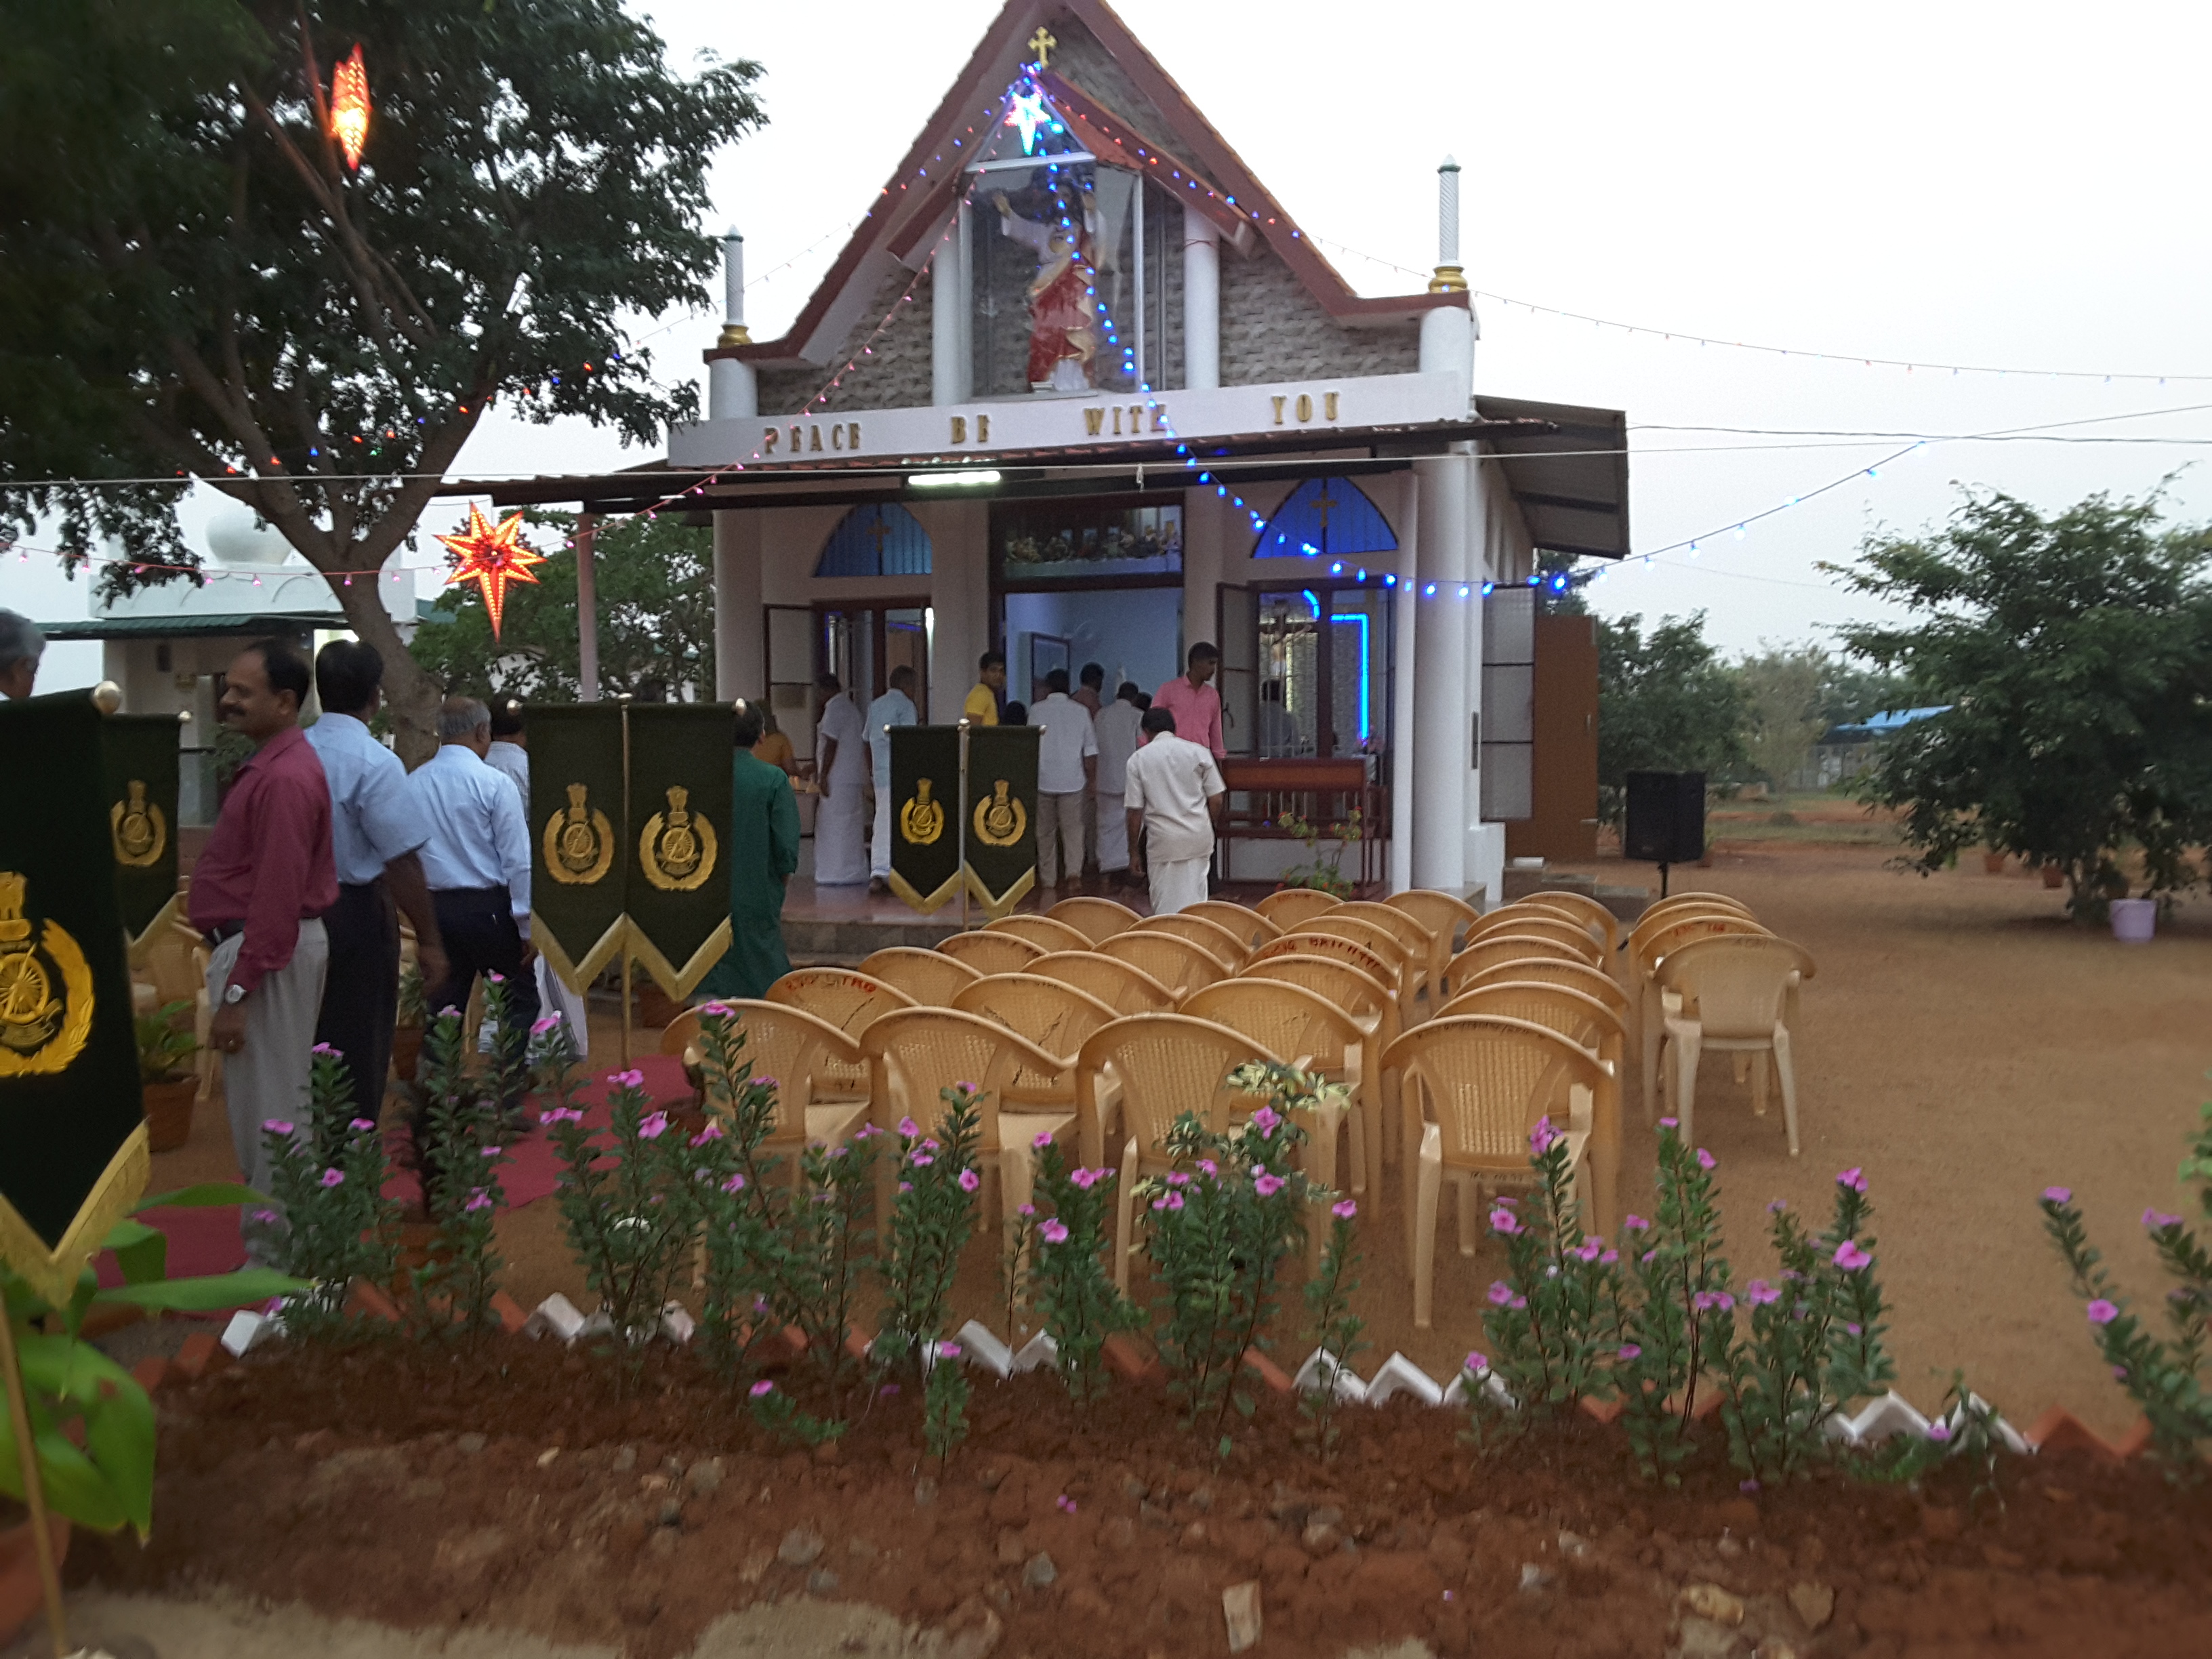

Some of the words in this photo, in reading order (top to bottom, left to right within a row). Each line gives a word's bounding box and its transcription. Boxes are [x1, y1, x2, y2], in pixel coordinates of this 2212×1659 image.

[763, 422, 861, 454] PEACE
[950, 415, 991, 444] BE
[1271, 391, 1340, 425] YOU
